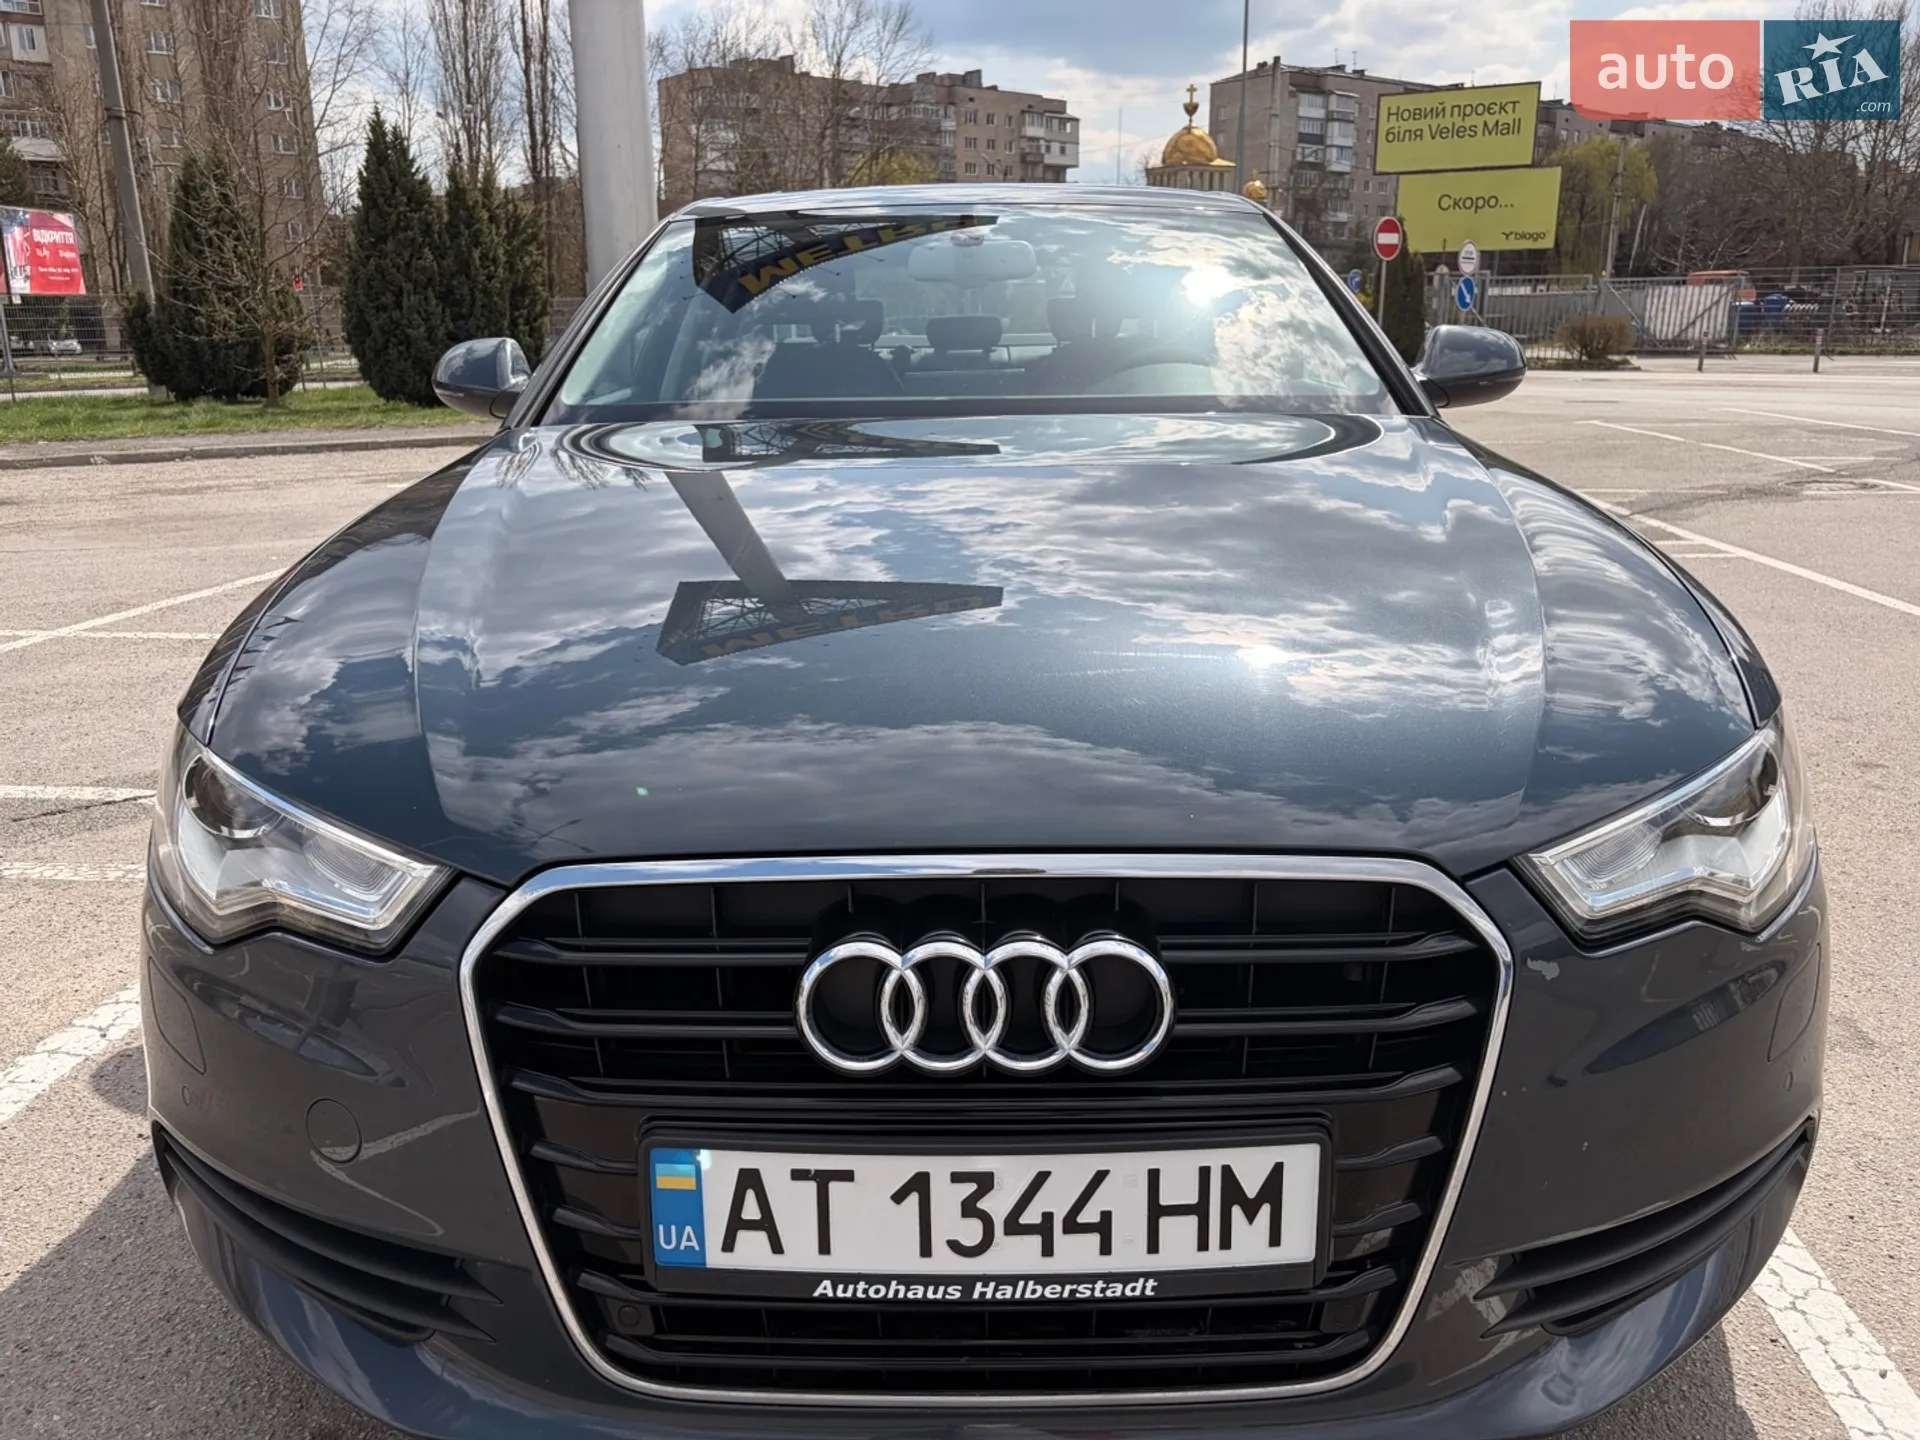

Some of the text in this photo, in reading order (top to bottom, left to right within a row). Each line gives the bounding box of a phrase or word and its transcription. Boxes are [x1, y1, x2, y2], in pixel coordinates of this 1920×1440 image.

[1386, 100, 1520, 123] Новий проєкт
[1385, 118, 1522, 143] біля Veles Mall
[1438, 193, 1514, 214] Скоро...
[658, 1161, 1285, 1260] UA AT 1344 HM
[813, 1276, 1158, 1300] Autohaus Halberstadt
